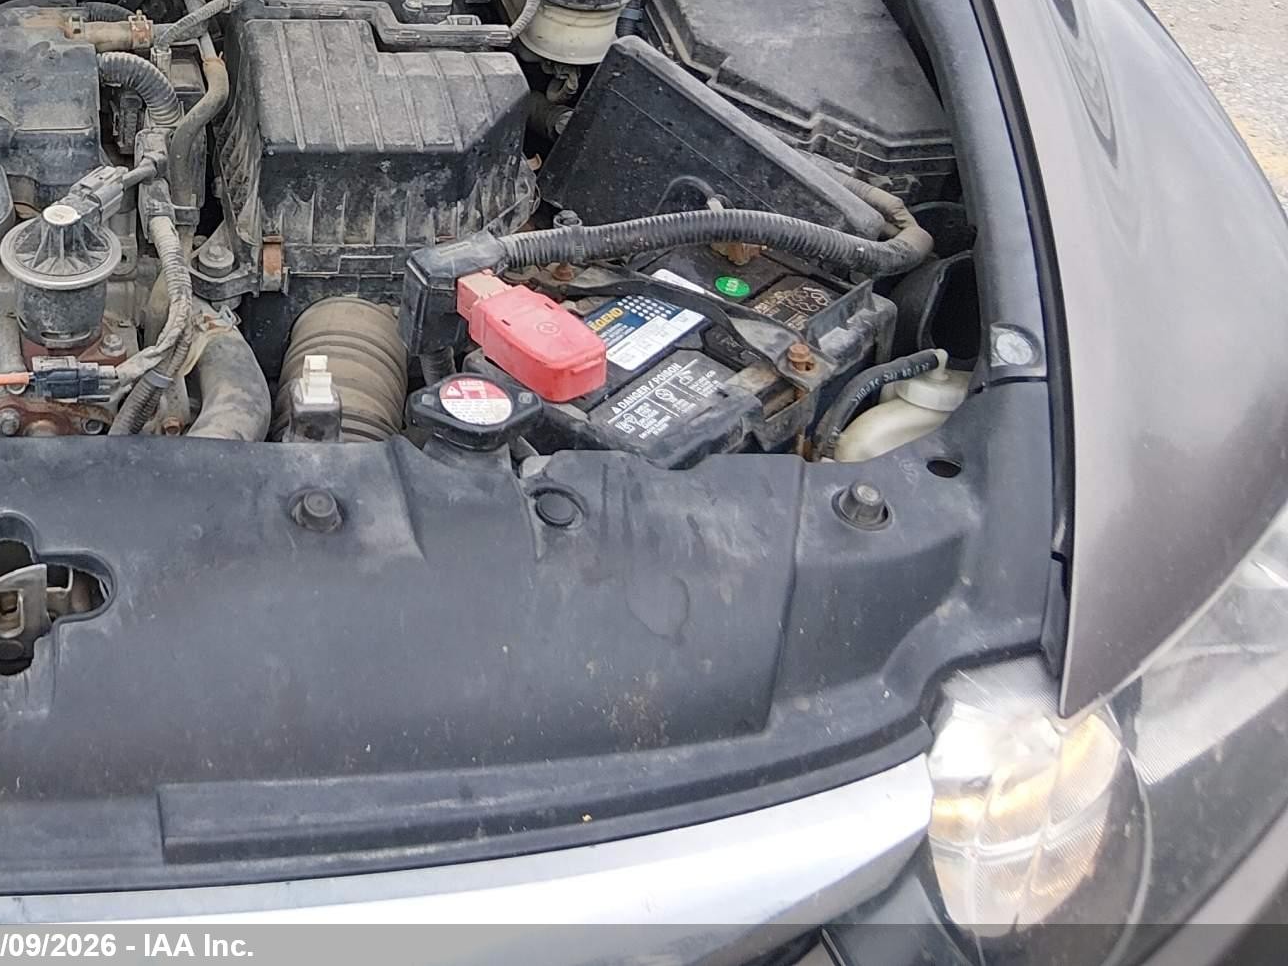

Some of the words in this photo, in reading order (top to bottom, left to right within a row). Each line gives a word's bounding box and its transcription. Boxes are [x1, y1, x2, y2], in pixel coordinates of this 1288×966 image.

[589, 307, 624, 331] EGEND
[616, 383, 650, 411] DANGER
[653, 362, 683, 385] POISON
